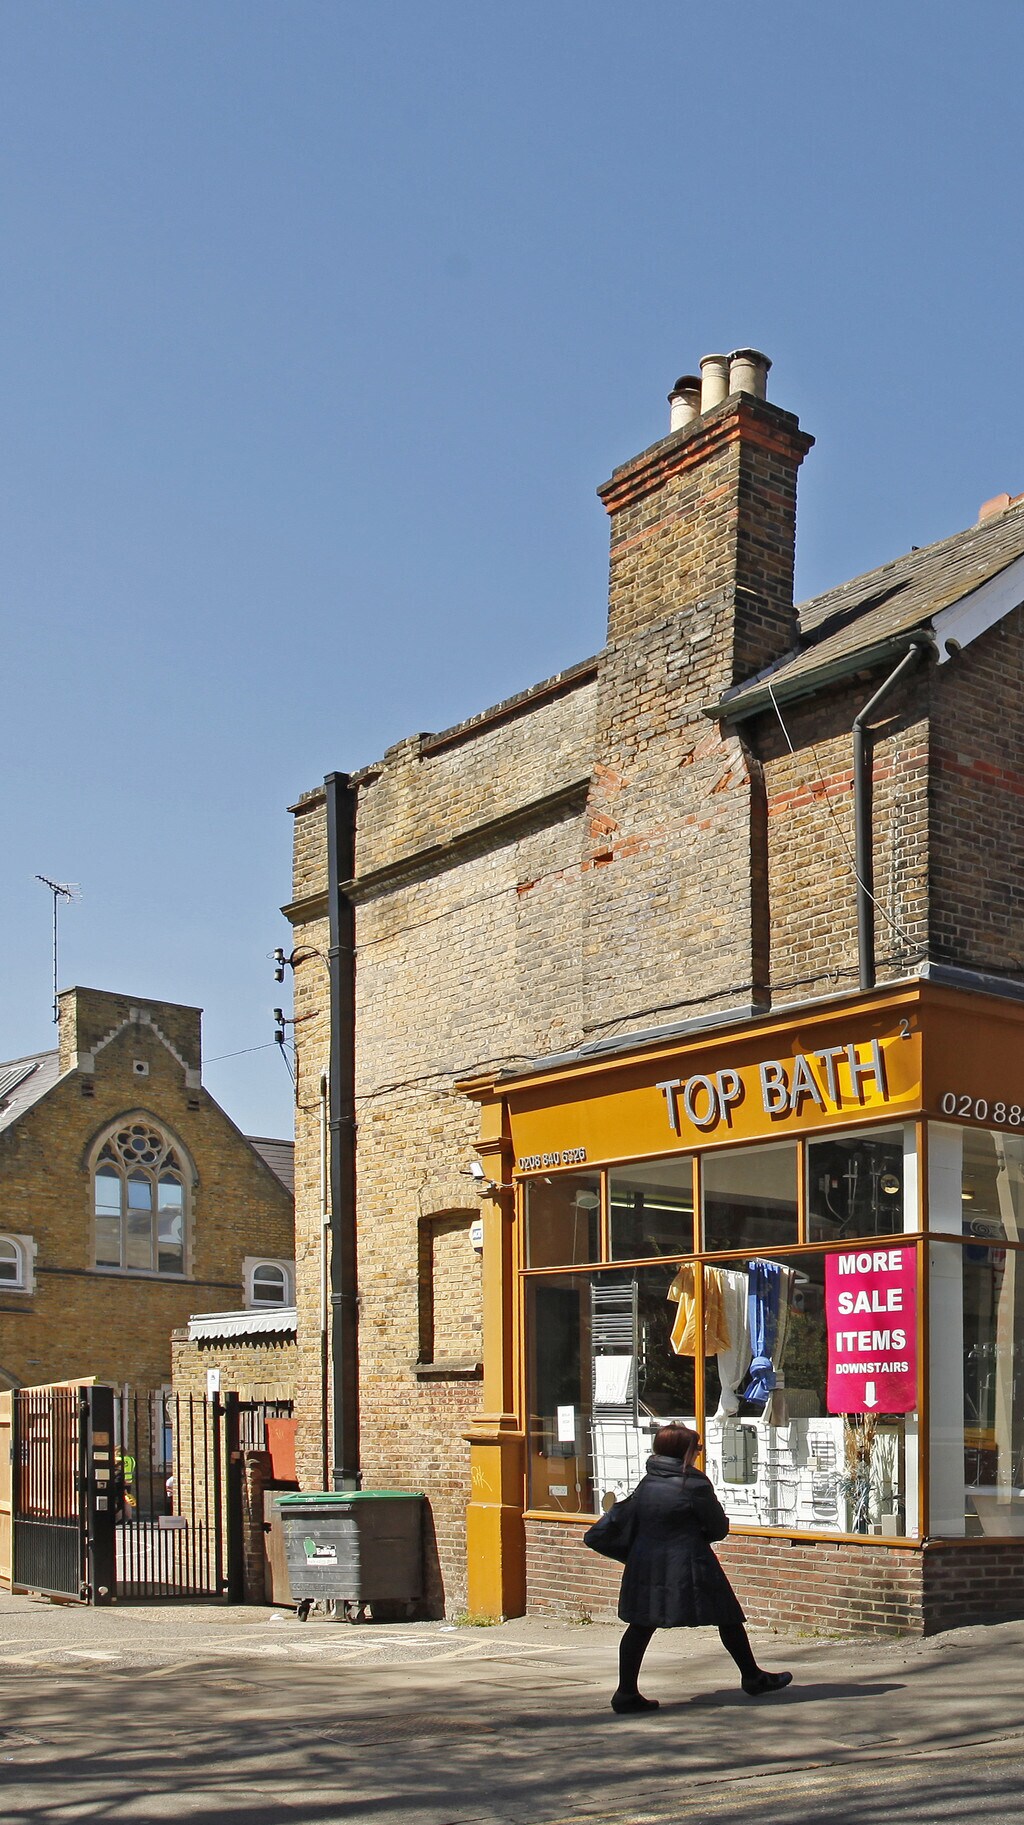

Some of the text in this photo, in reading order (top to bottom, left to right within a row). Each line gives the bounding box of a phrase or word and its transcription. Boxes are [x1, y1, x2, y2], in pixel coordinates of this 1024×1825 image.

[899, 1018, 911, 1038] 2
[656, 1038, 886, 1129] TOP BATH
[942, 1092, 988, 1121] 020
[518, 1146, 586, 1170] 0208 840 6326
[838, 1250, 902, 1275] MORE
[837, 1288, 903, 1315] SALE
[837, 1330, 906, 1352] ITEMS
[835, 1361, 909, 1375] DOWNSTAIRS
